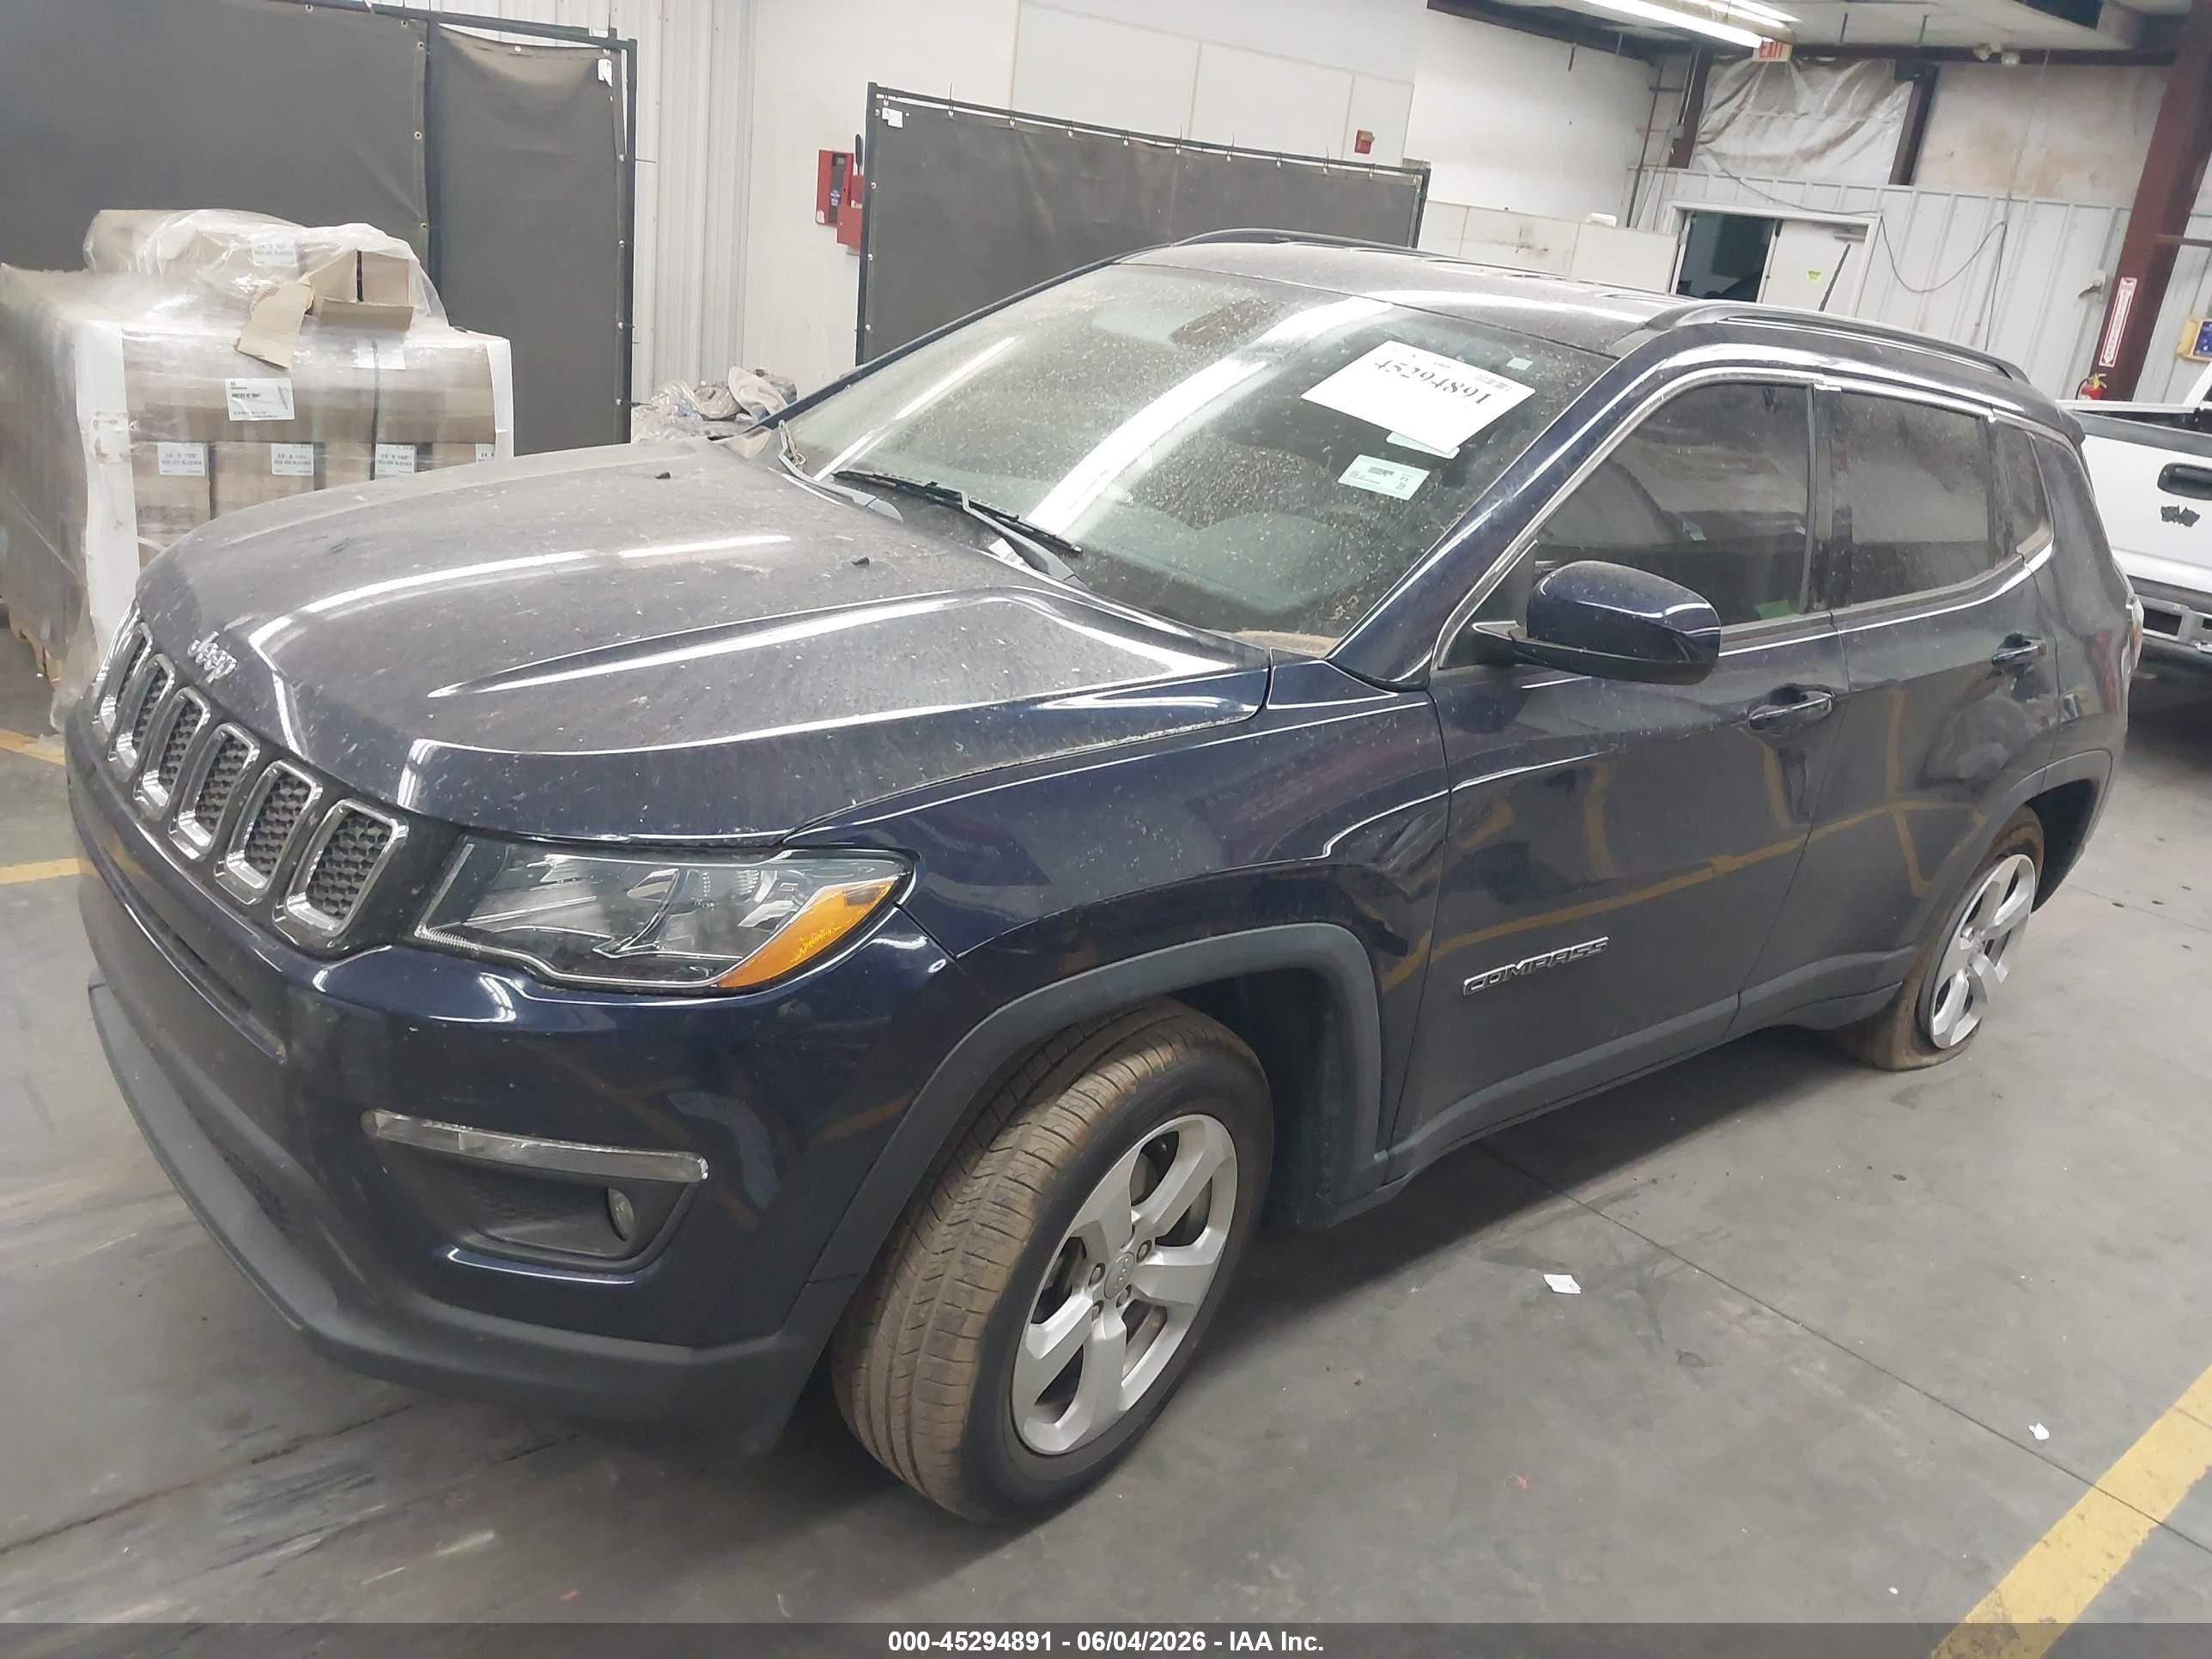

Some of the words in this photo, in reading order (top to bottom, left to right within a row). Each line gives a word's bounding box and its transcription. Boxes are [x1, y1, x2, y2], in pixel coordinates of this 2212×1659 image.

[1374, 359, 1492, 404] 45294891
[187, 630, 237, 684] Jeep
[1462, 936, 1609, 996] COMPASS
